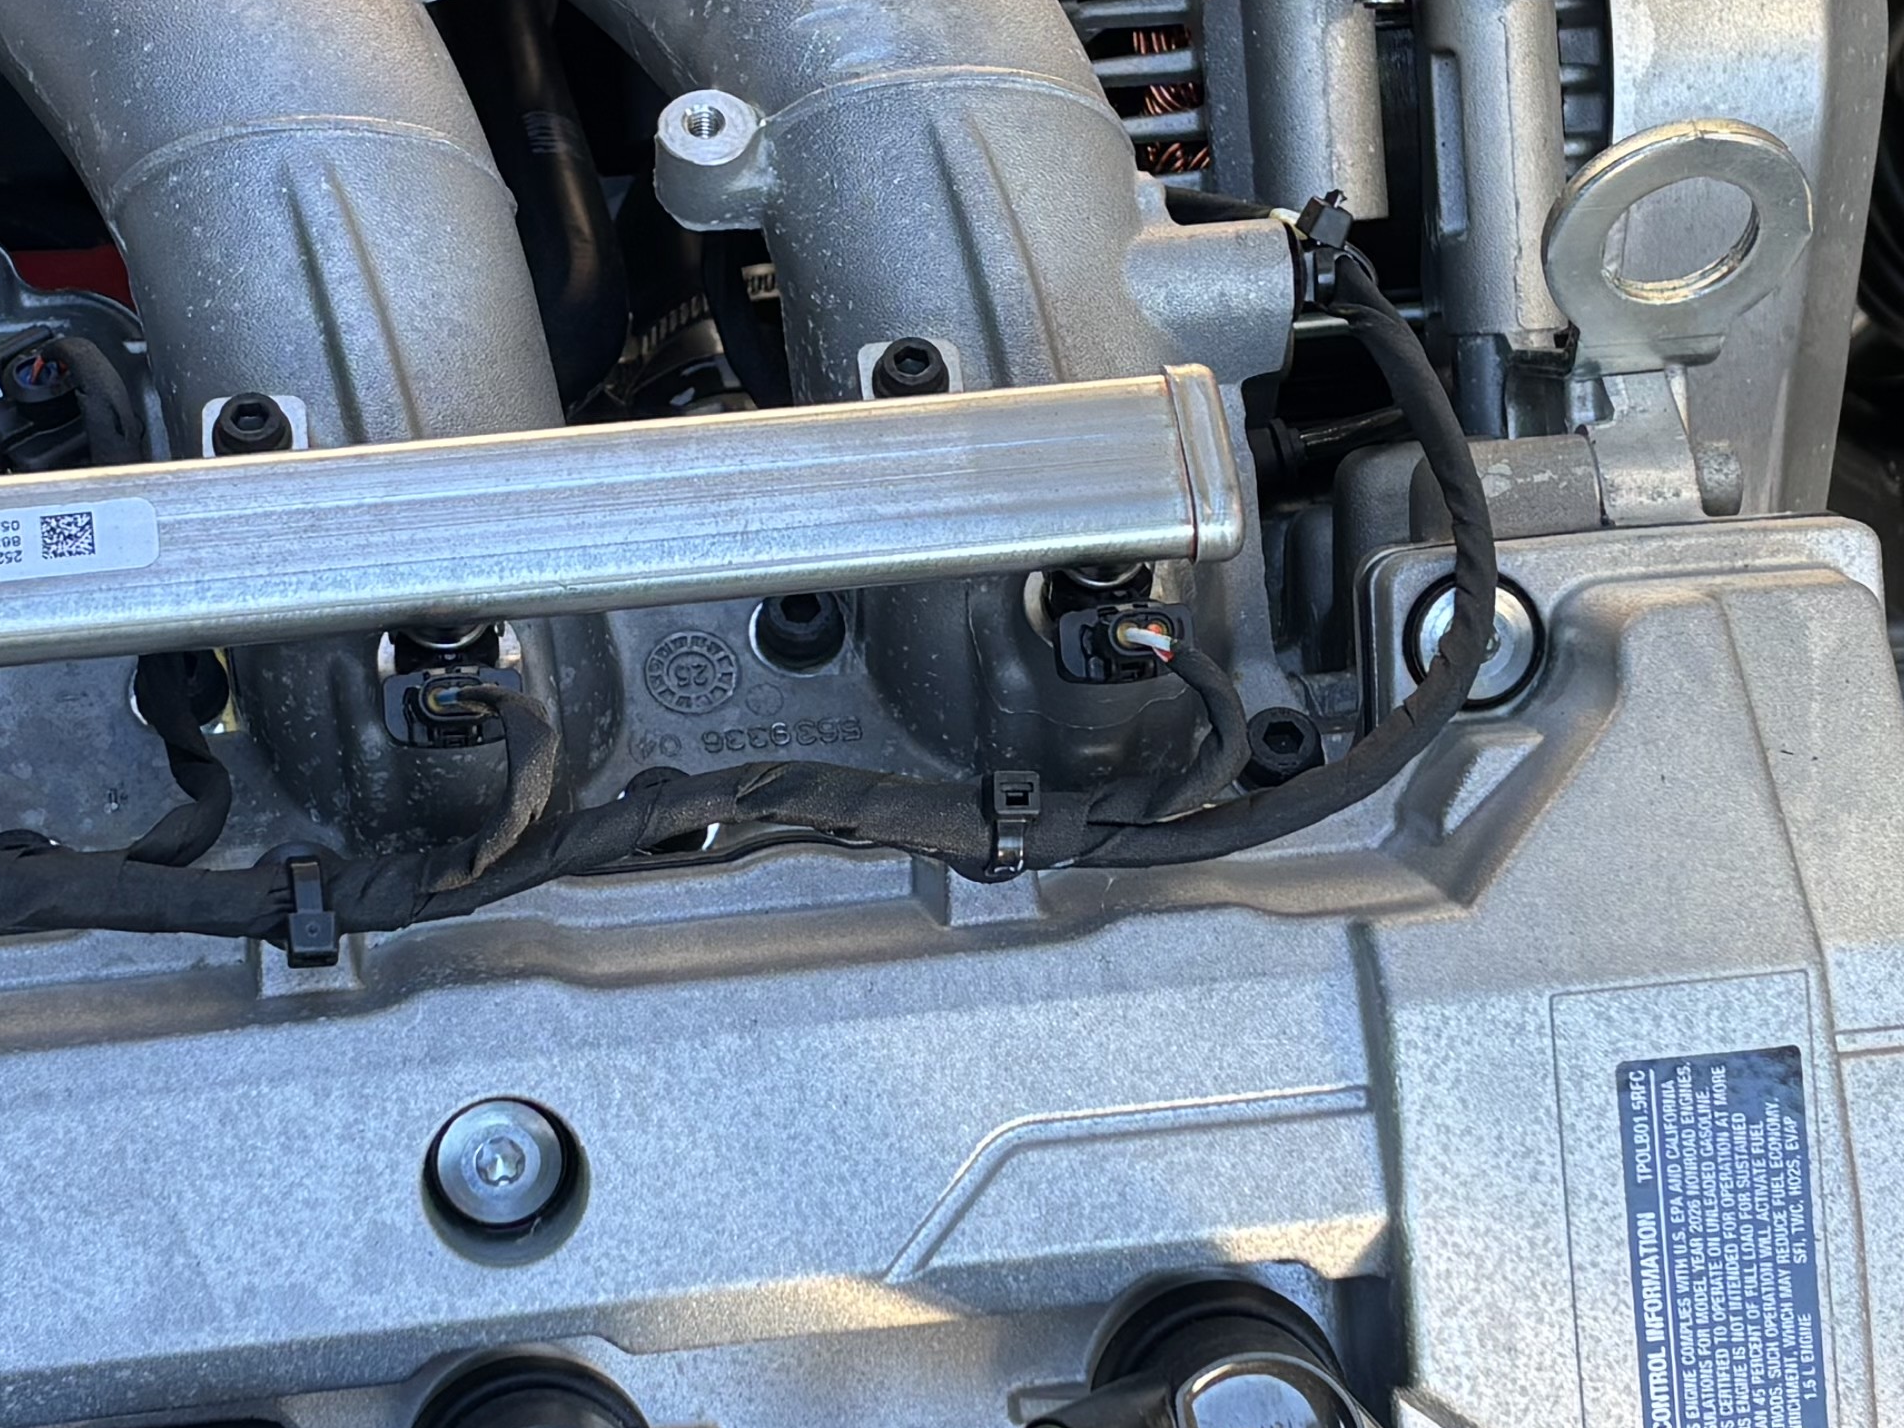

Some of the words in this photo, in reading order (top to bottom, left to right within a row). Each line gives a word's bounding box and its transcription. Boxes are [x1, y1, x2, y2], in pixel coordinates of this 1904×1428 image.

[701, 716, 863, 755] 5639336
[1711, 1065, 1728, 1105] MORE
[1660, 1079, 1680, 1159] CALIFORNIA
[1715, 1110, 1729, 1128] AT
[1749, 1120, 1765, 1154] FUEL
[1783, 1115, 1799, 1150] EVAP
[1681, 1127, 1700, 1195] NONROAD
[1732, 1111, 1750, 1188] SUSTAINED
[1667, 1163, 1682, 1193] AND
[1716, 1131, 1735, 1207] OPERATION
[1701, 1161, 1720, 1232] UNLEADED
[1737, 1192, 1753, 1219] FOR
[1752, 1157, 1770, 1221] ACTIVATE
[1770, 1172, 1786, 1206] FUEL
[1669, 1196, 1685, 1223] EPA
[1687, 1199, 1703, 1232] 2026
[1722, 1212, 1737, 1238] FOR
[1672, 1227, 1687, 1254] U.S.
[1689, 1237, 1706, 1272] YEAR
[1706, 1236, 1721, 1256] ON
[1740, 1223, 1756, 1260] LOAD
[1757, 1225, 1773, 1257] WILL
[1773, 1209, 1790, 1264] REDUCE
[1636, 1211, 1665, 1341] INFORMATION
[1674, 1258, 1690, 1292] WITH
[1708, 1260, 1726, 1321] OPERATE
[1724, 1243, 1743, 1310] INTENDED
[1743, 1263, 1758, 1296] FULL
[1777, 1267, 1793, 1298] MAY
[1692, 1276, 1709, 1324] MODEL
[1745, 1301, 1760, 1319] OF
[1760, 1262, 1778, 1337] OPERATION
[1677, 1297, 1695, 1364] COMPLIES
[1696, 1328, 1712, 1355] FOR
[1713, 1326, 1728, 1343] TO
[1730, 1314, 1745, 1341] NOT
[1779, 1302, 1796, 1347] WHICH
[1798, 1312, 1814, 1362] ENGINE
[1732, 1345, 1746, 1359] IS
[1747, 1323, 1765, 1383] PERCENT
[1765, 1341, 1781, 1378] SUCH
[1682, 1368, 1699, 1418] ENGINE
[1715, 1347, 1733, 1415] CERTIFIED
[1733, 1363, 1750, 1413] ENGINE
[1752, 1388, 1766, 1405] 45
[1802, 1378, 1817, 1399] 1.5
